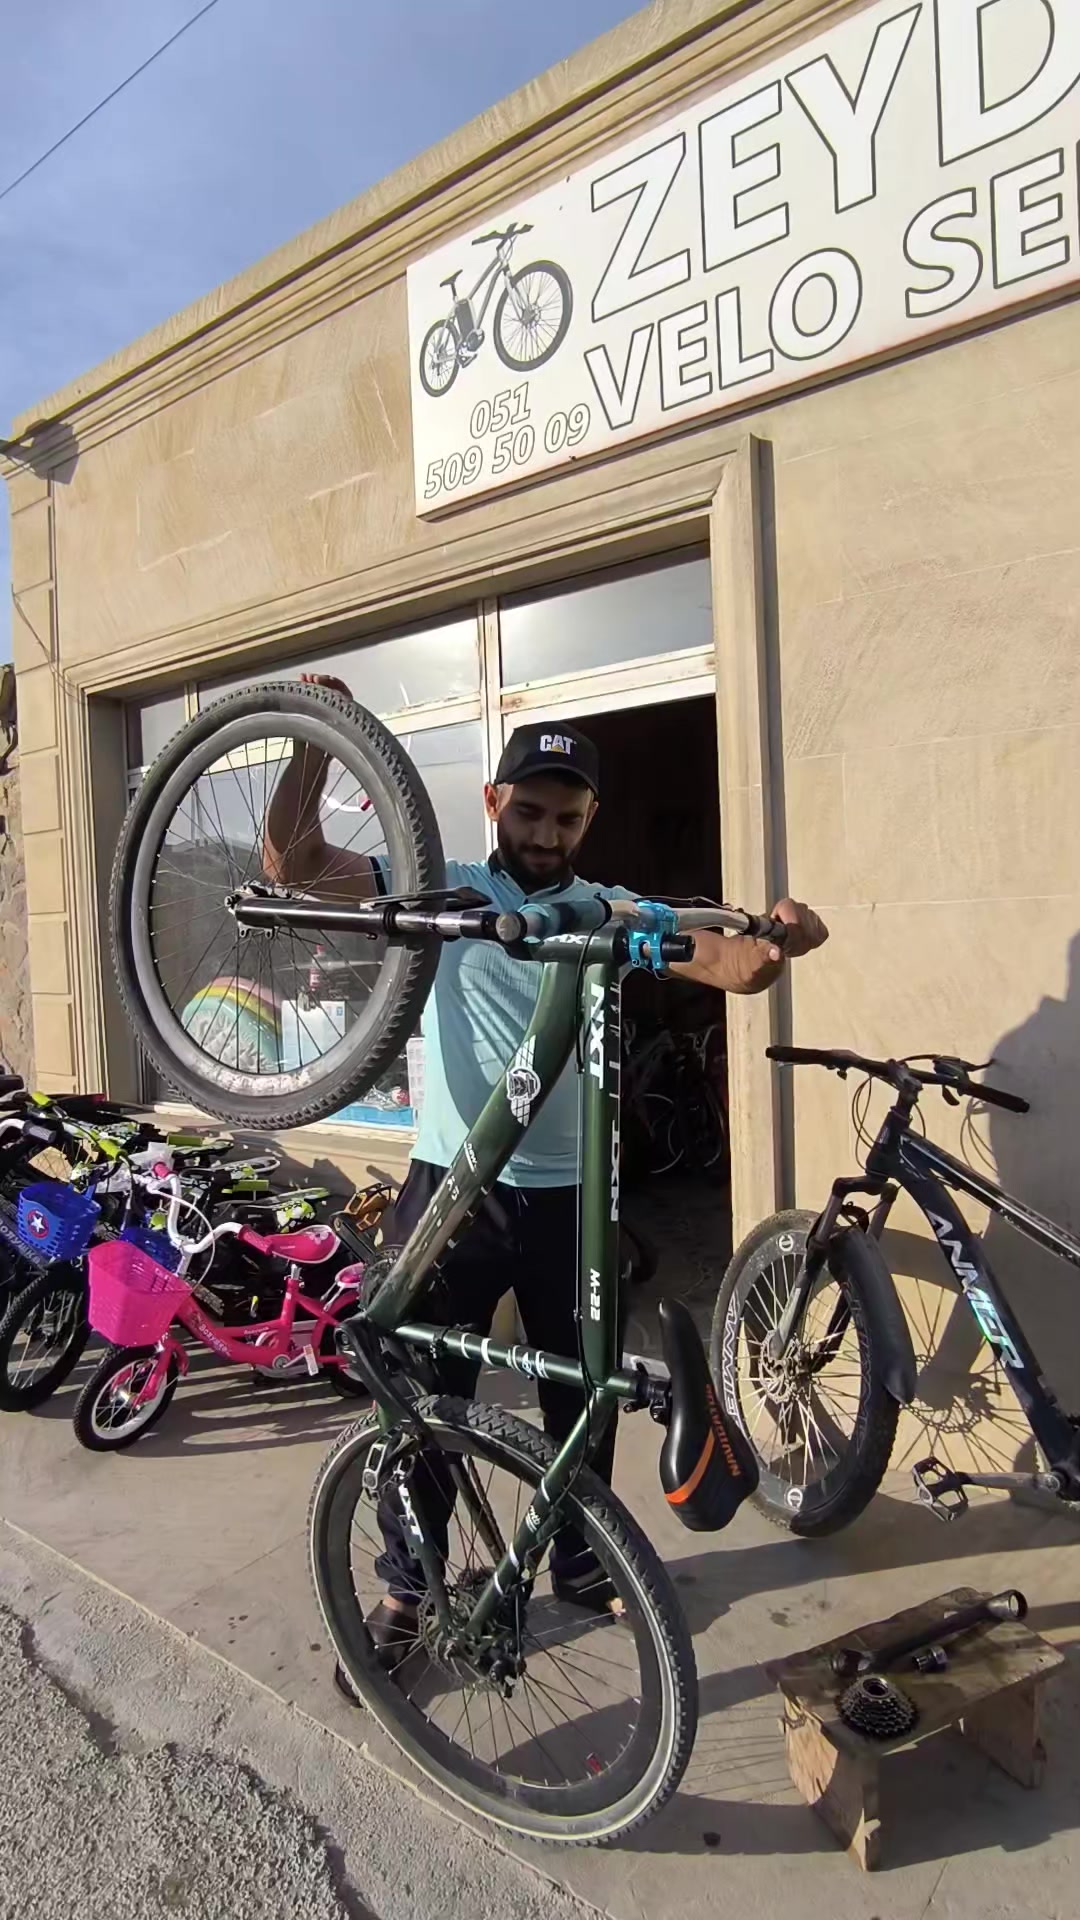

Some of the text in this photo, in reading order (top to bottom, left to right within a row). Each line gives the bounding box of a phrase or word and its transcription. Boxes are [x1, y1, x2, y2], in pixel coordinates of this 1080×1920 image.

[591, 0, 1080, 322] ZEYD
[584, 139, 1080, 429] VELO SE
[424, 403, 591, 499] 509 50 09
[470, 381, 532, 439] 051
[540, 734, 573, 754] CAT
[589, 982, 605, 1089] NXT
[590, 1267, 601, 1321] M-22
[721, 1290, 745, 1426] ANMIE
